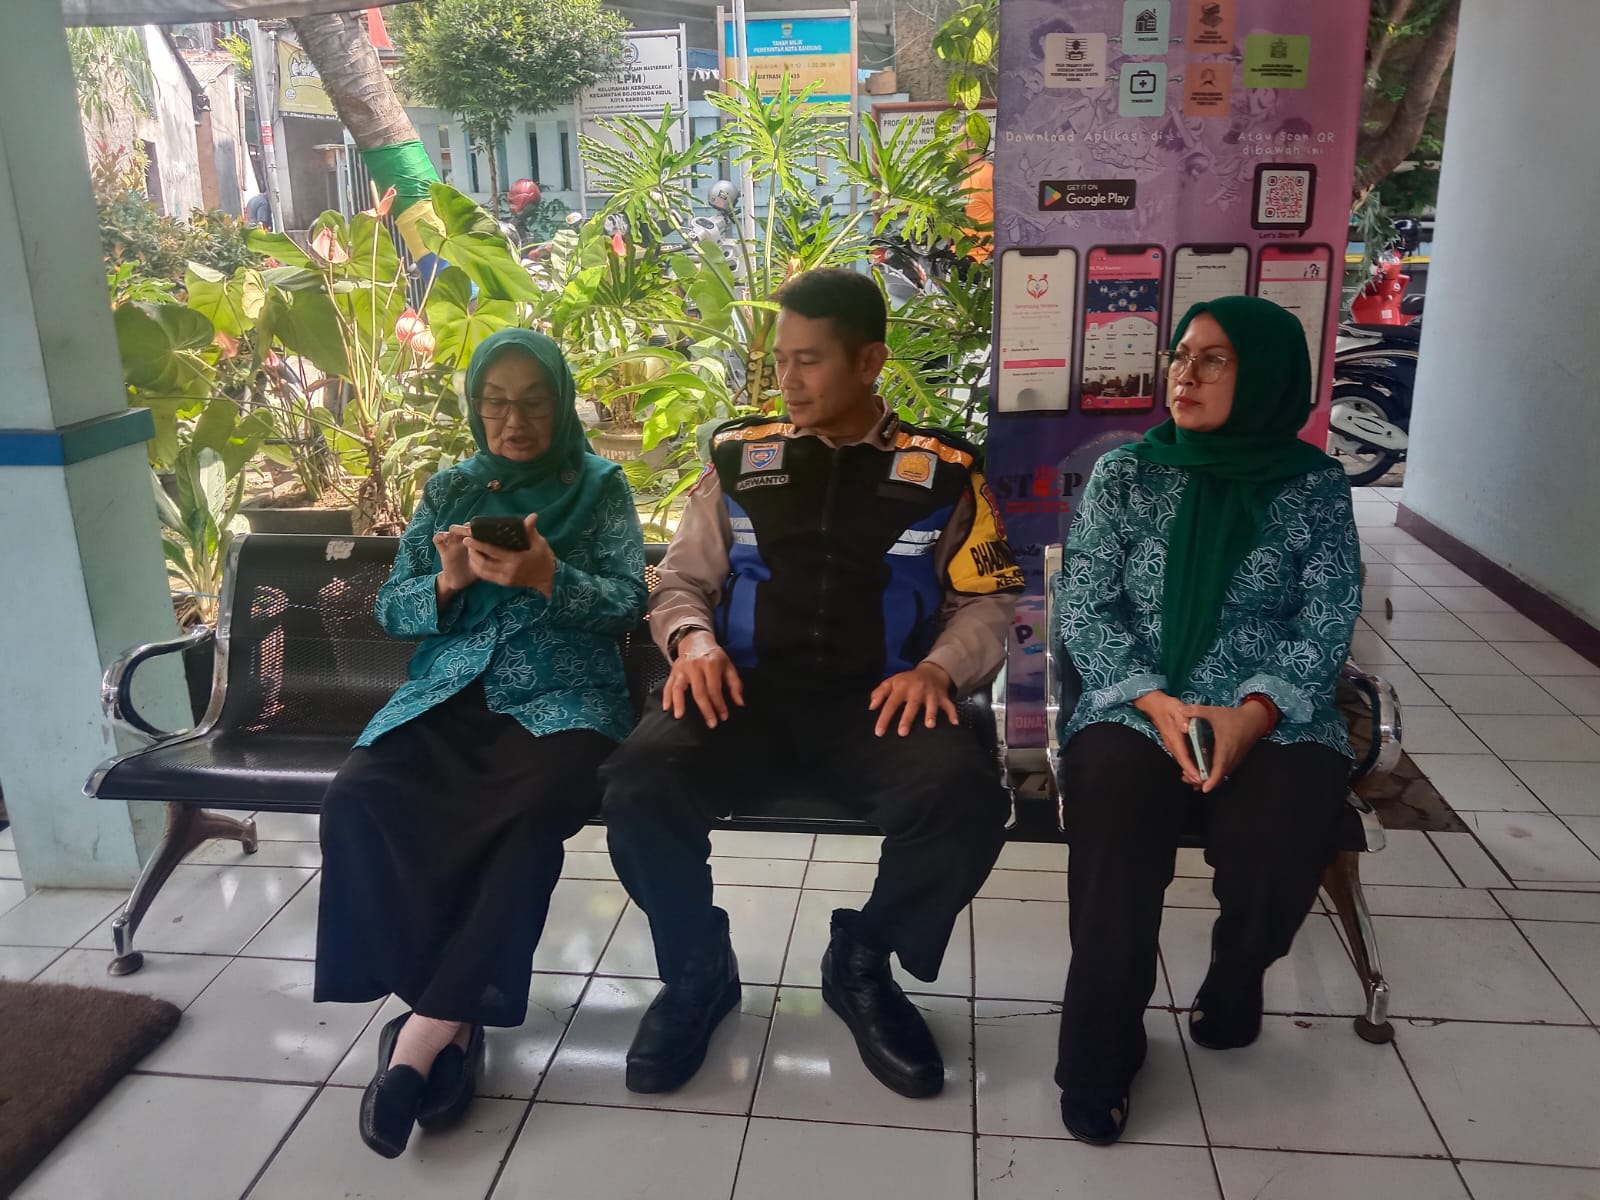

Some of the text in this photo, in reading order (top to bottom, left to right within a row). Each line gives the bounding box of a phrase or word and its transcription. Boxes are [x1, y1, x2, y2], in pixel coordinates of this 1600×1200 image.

[1005, 131, 1075, 142] Download
[1083, 131, 1143, 143] Aplikasi
[1238, 131, 1335, 142] Atau Scan QR
[1242, 144, 1300, 155] dibawah
[1066, 192, 1130, 206] Google Play
